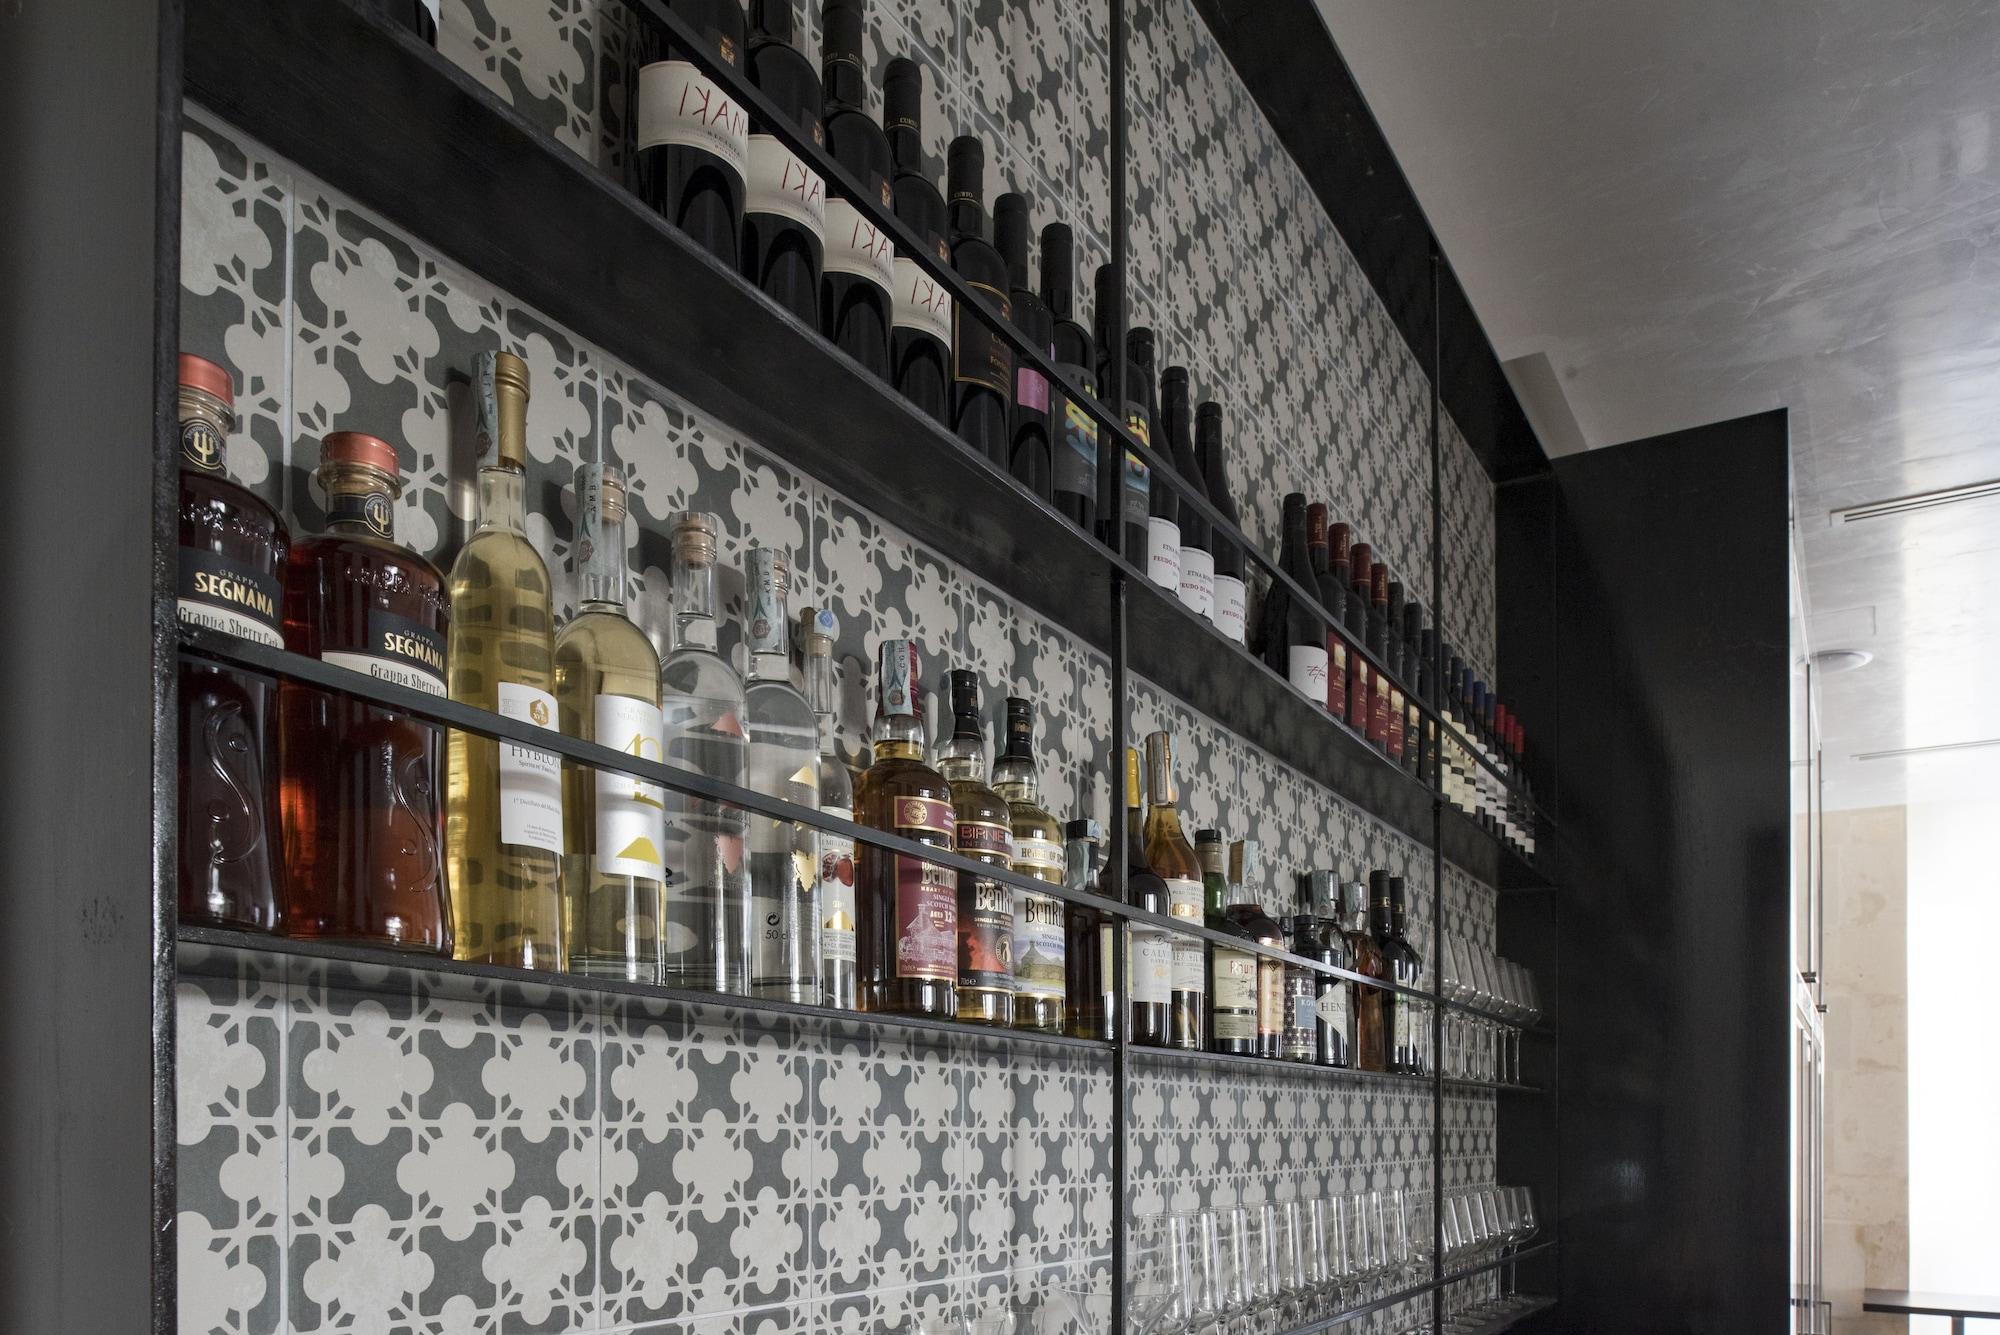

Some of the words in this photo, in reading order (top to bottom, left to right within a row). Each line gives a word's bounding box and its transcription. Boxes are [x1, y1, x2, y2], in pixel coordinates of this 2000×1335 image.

[219, 568, 259, 589] GRAPPA
[194, 571, 274, 619] SEGNANA
[404, 629, 434, 647] GRAPPA
[384, 632, 444, 673] SEGNANA
[370, 663, 409, 685] Grappa
[765, 929, 778, 940] 50
